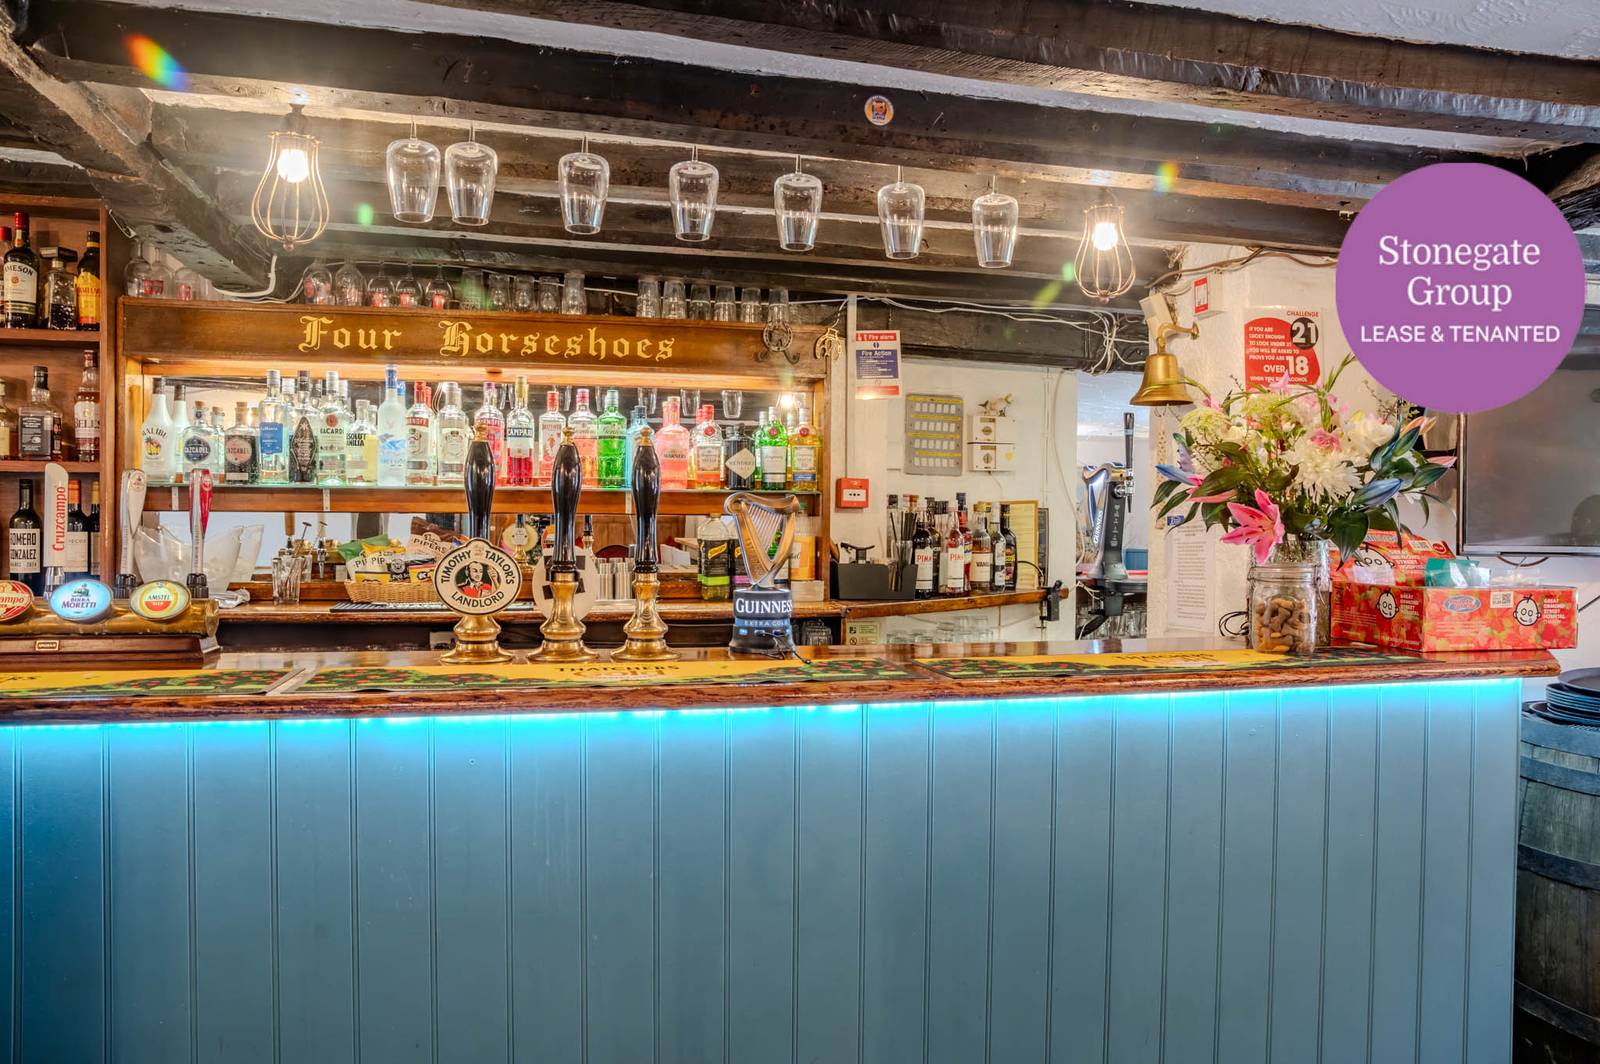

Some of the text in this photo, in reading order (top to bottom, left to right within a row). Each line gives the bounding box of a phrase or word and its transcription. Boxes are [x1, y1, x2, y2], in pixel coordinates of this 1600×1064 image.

[5, 263, 33, 277] AMESON
[299, 315, 675, 362] Four Horseshoes
[1291, 321, 1317, 344] 21
[1263, 355, 1310, 375] OVER 18
[51, 486, 67, 552] Cruzcampo
[371, 556, 386, 565] PIP
[440, 549, 516, 586] TIMOTHY TAYLOR'S
[61, 601, 97, 609] MORETTI
[451, 590, 505, 608] LANDLORD
